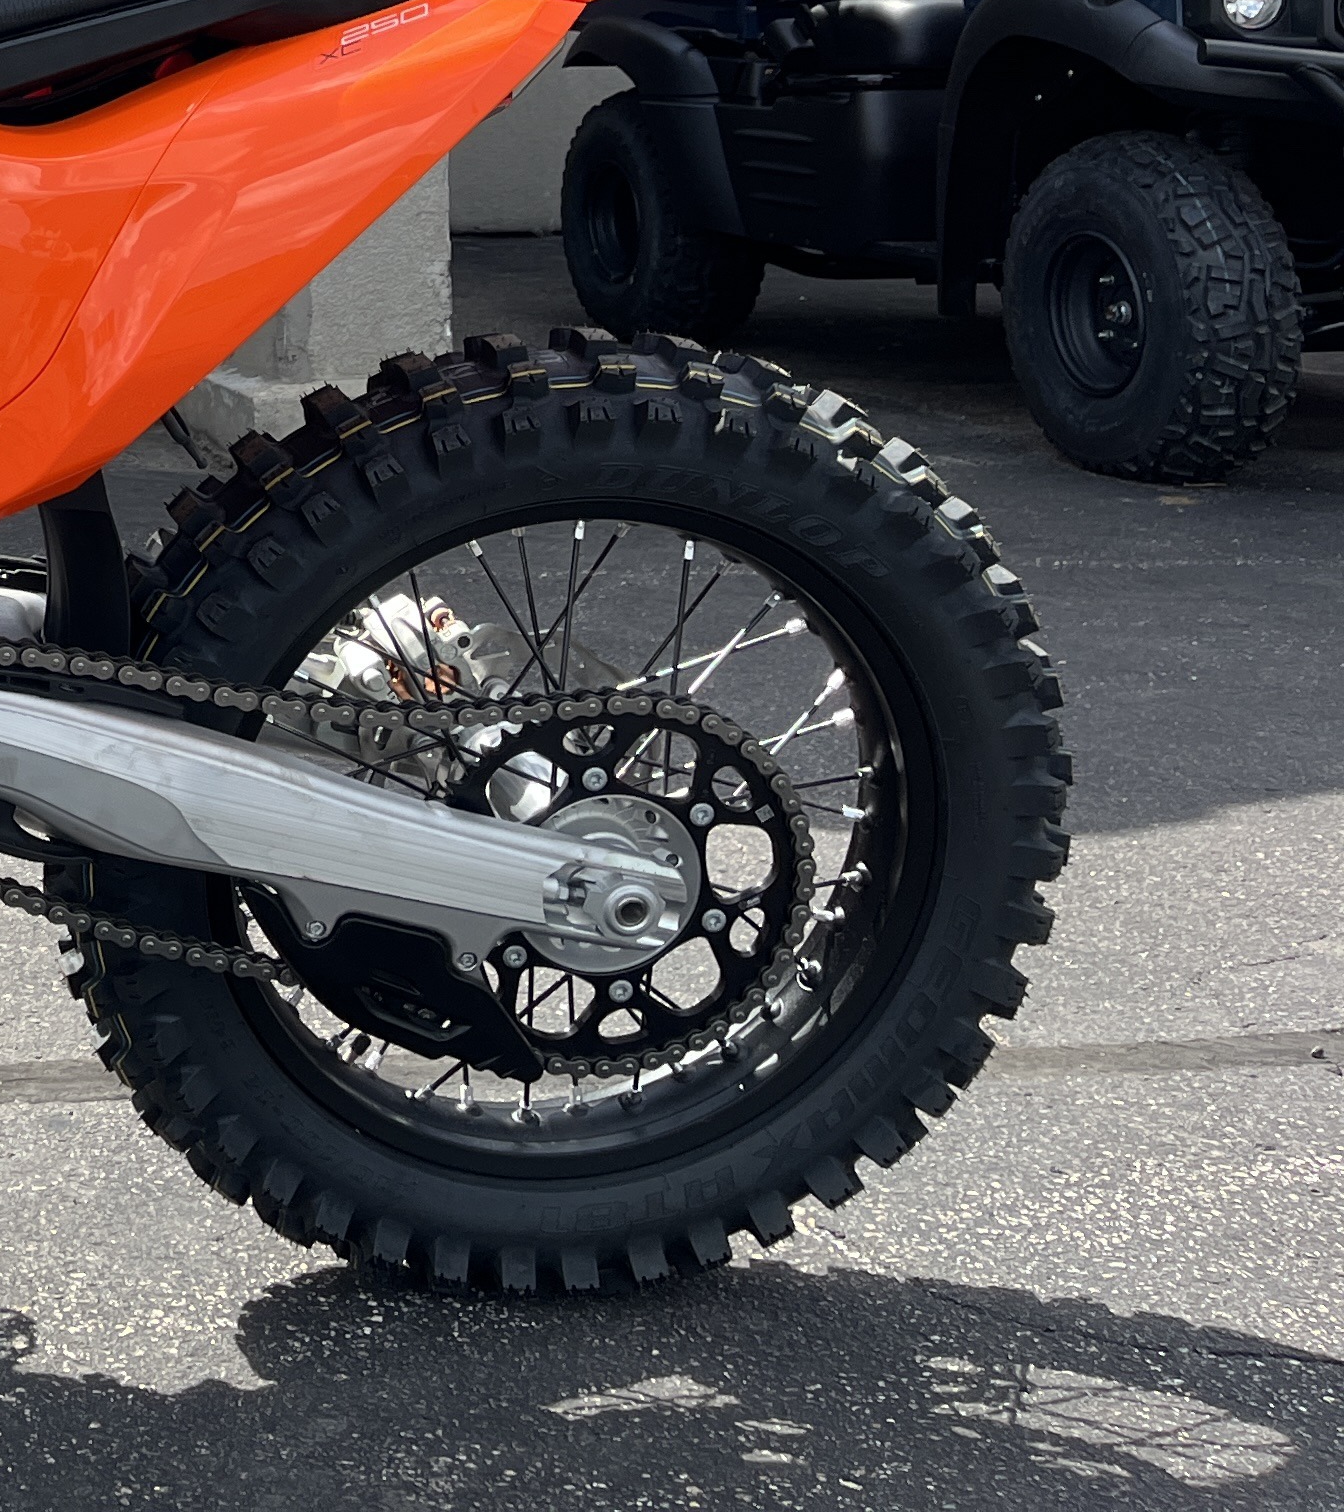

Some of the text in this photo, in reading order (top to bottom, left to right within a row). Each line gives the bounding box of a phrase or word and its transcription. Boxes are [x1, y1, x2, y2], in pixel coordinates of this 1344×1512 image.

[341, 2, 429, 46] 250
[319, 38, 362, 65] XC
[591, 461, 892, 579] DUNLOP
